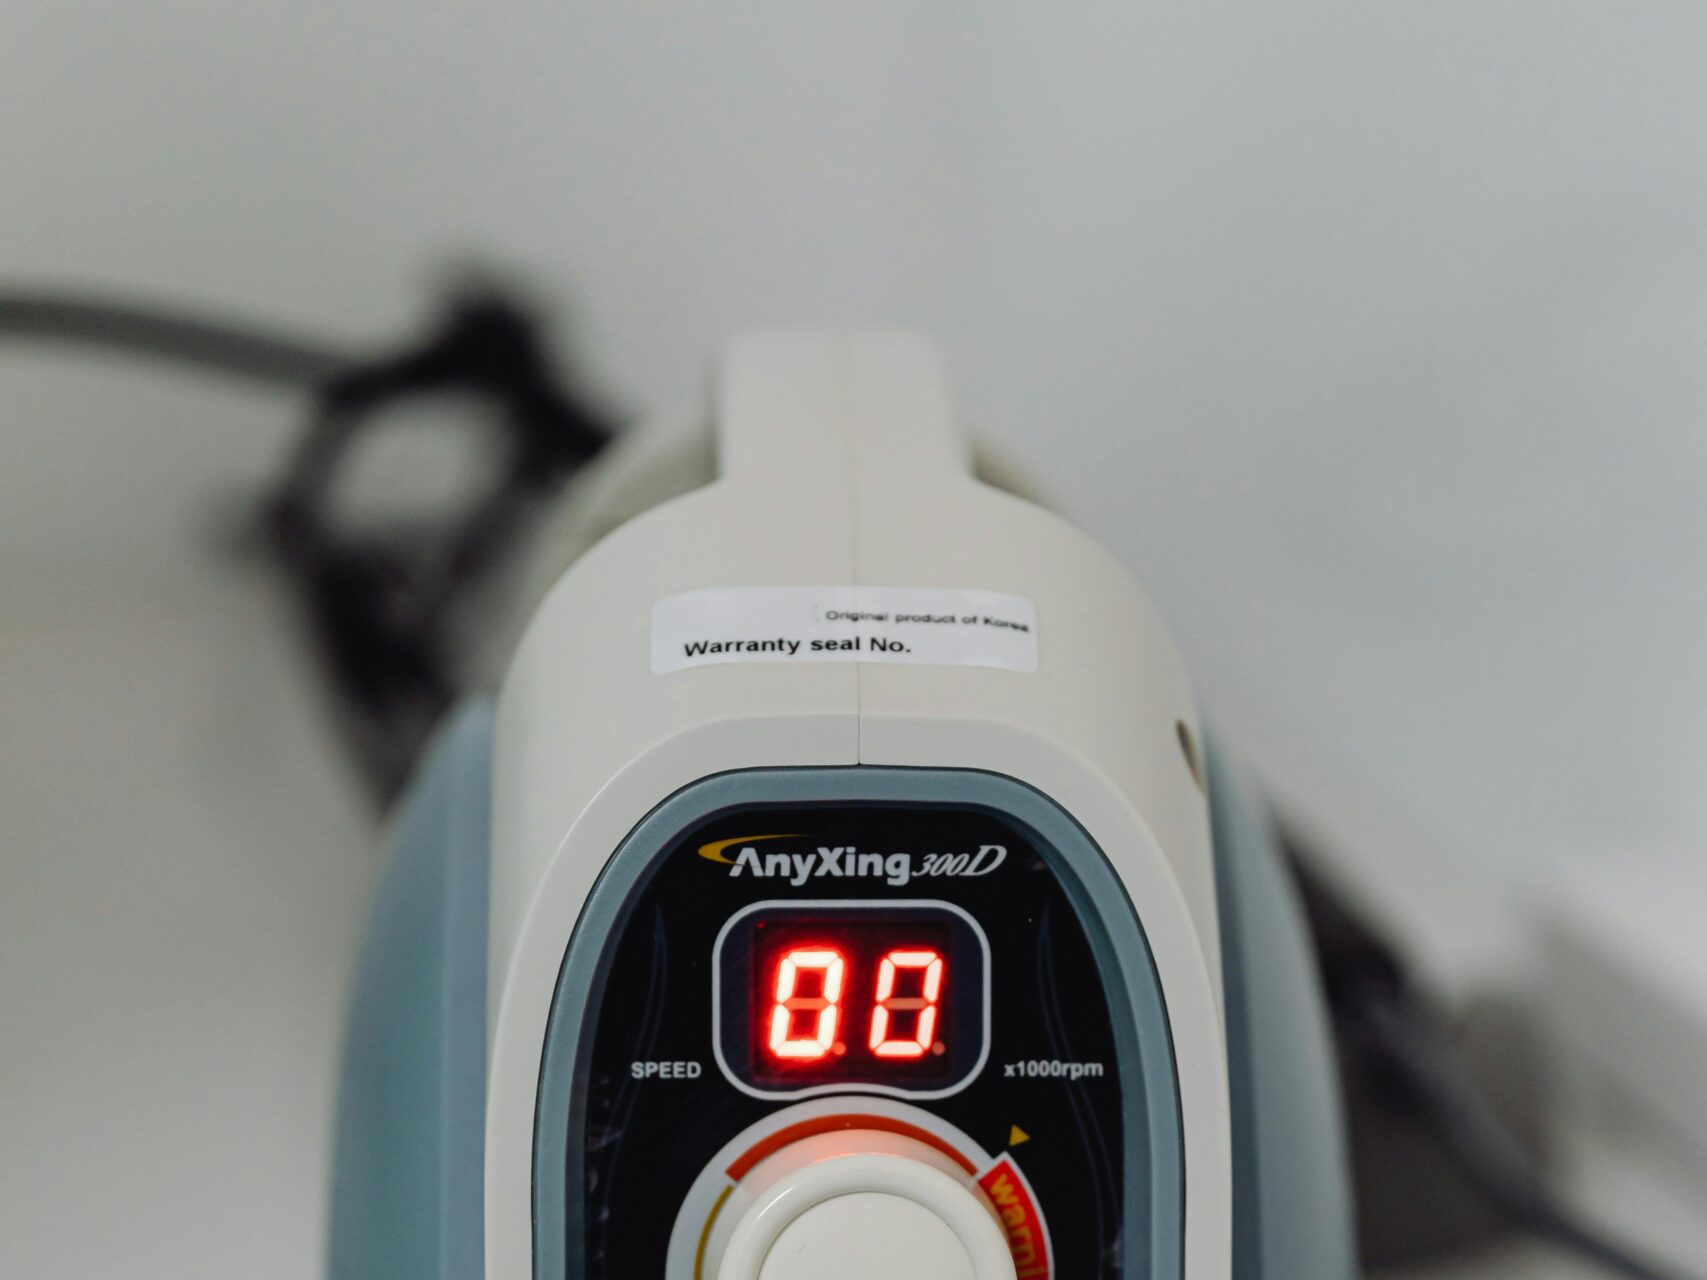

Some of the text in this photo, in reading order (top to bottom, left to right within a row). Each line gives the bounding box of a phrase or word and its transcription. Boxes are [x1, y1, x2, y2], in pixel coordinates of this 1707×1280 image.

[825, 609, 1029, 633] Original product of Korea
[684, 636, 911, 657] Warranty seal No.
[630, 1062, 701, 1079] SPEED
[1004, 1061, 1104, 1079] x1000rpm
